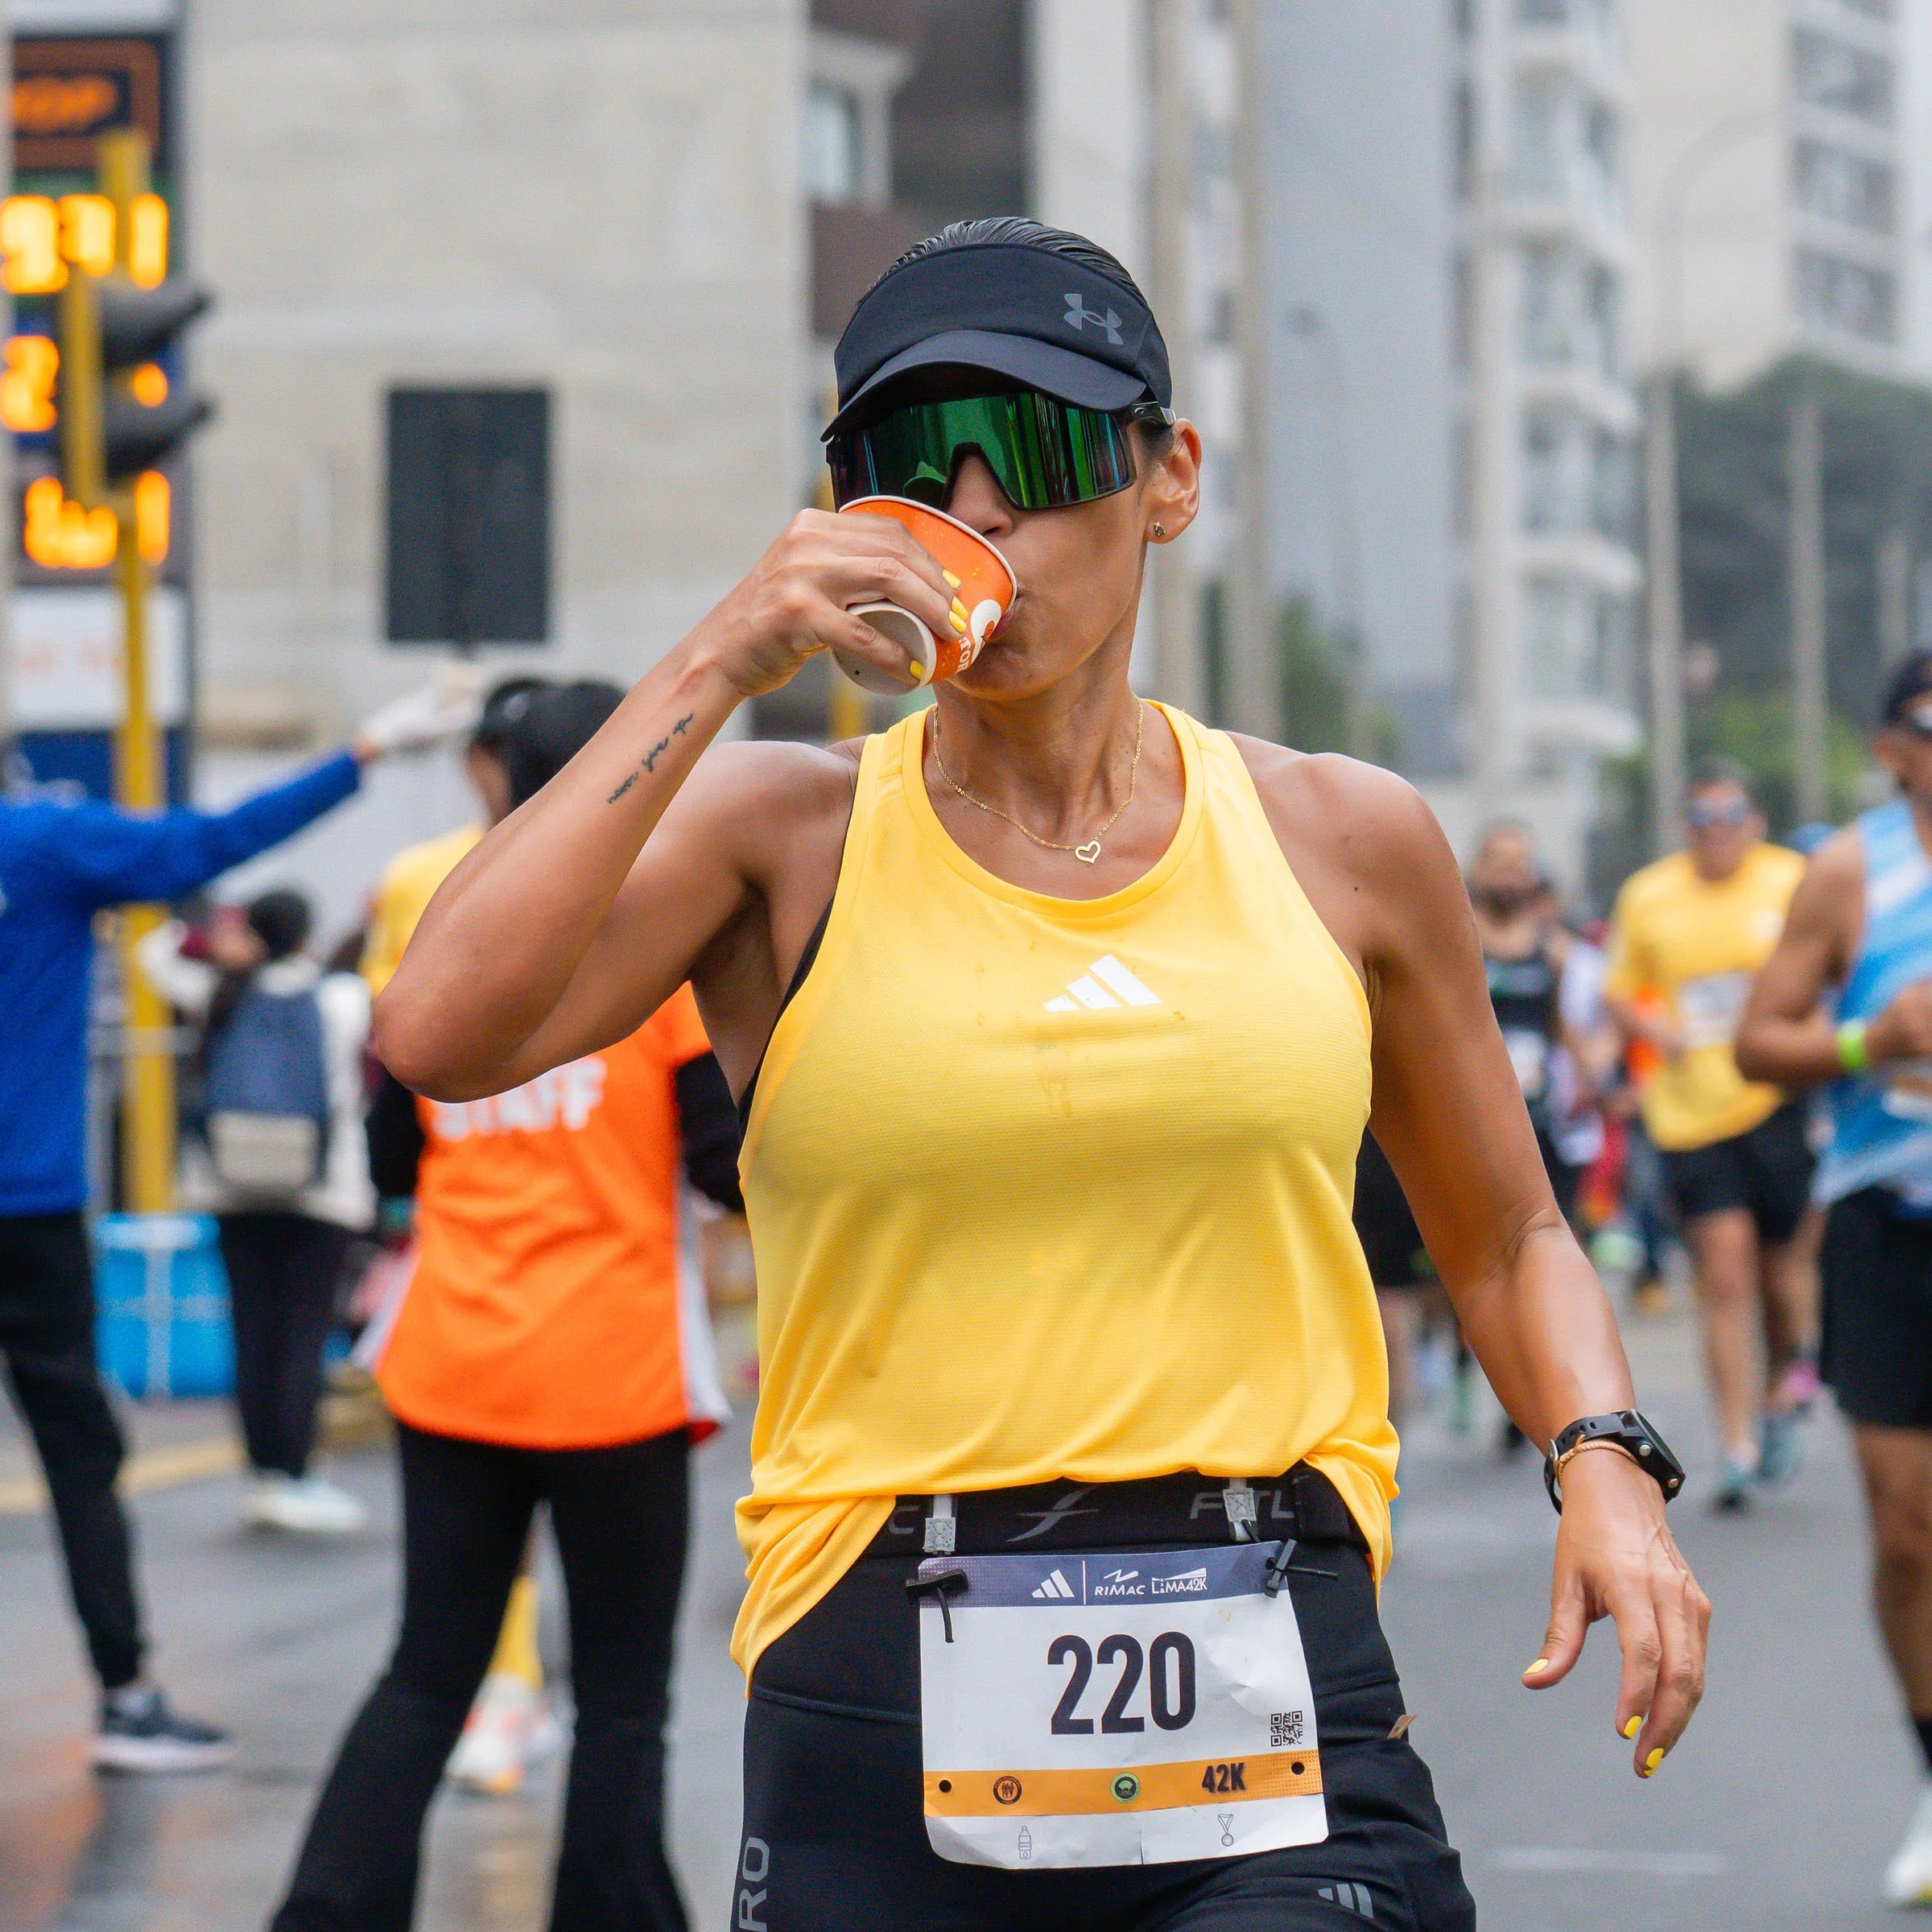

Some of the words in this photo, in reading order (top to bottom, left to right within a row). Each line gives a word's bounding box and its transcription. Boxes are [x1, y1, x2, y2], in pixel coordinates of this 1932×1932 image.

[1094, 1584, 1146, 1596] RIMAC
[1047, 1631, 1197, 1736] 220
[1201, 1761, 1246, 1794] 42K
